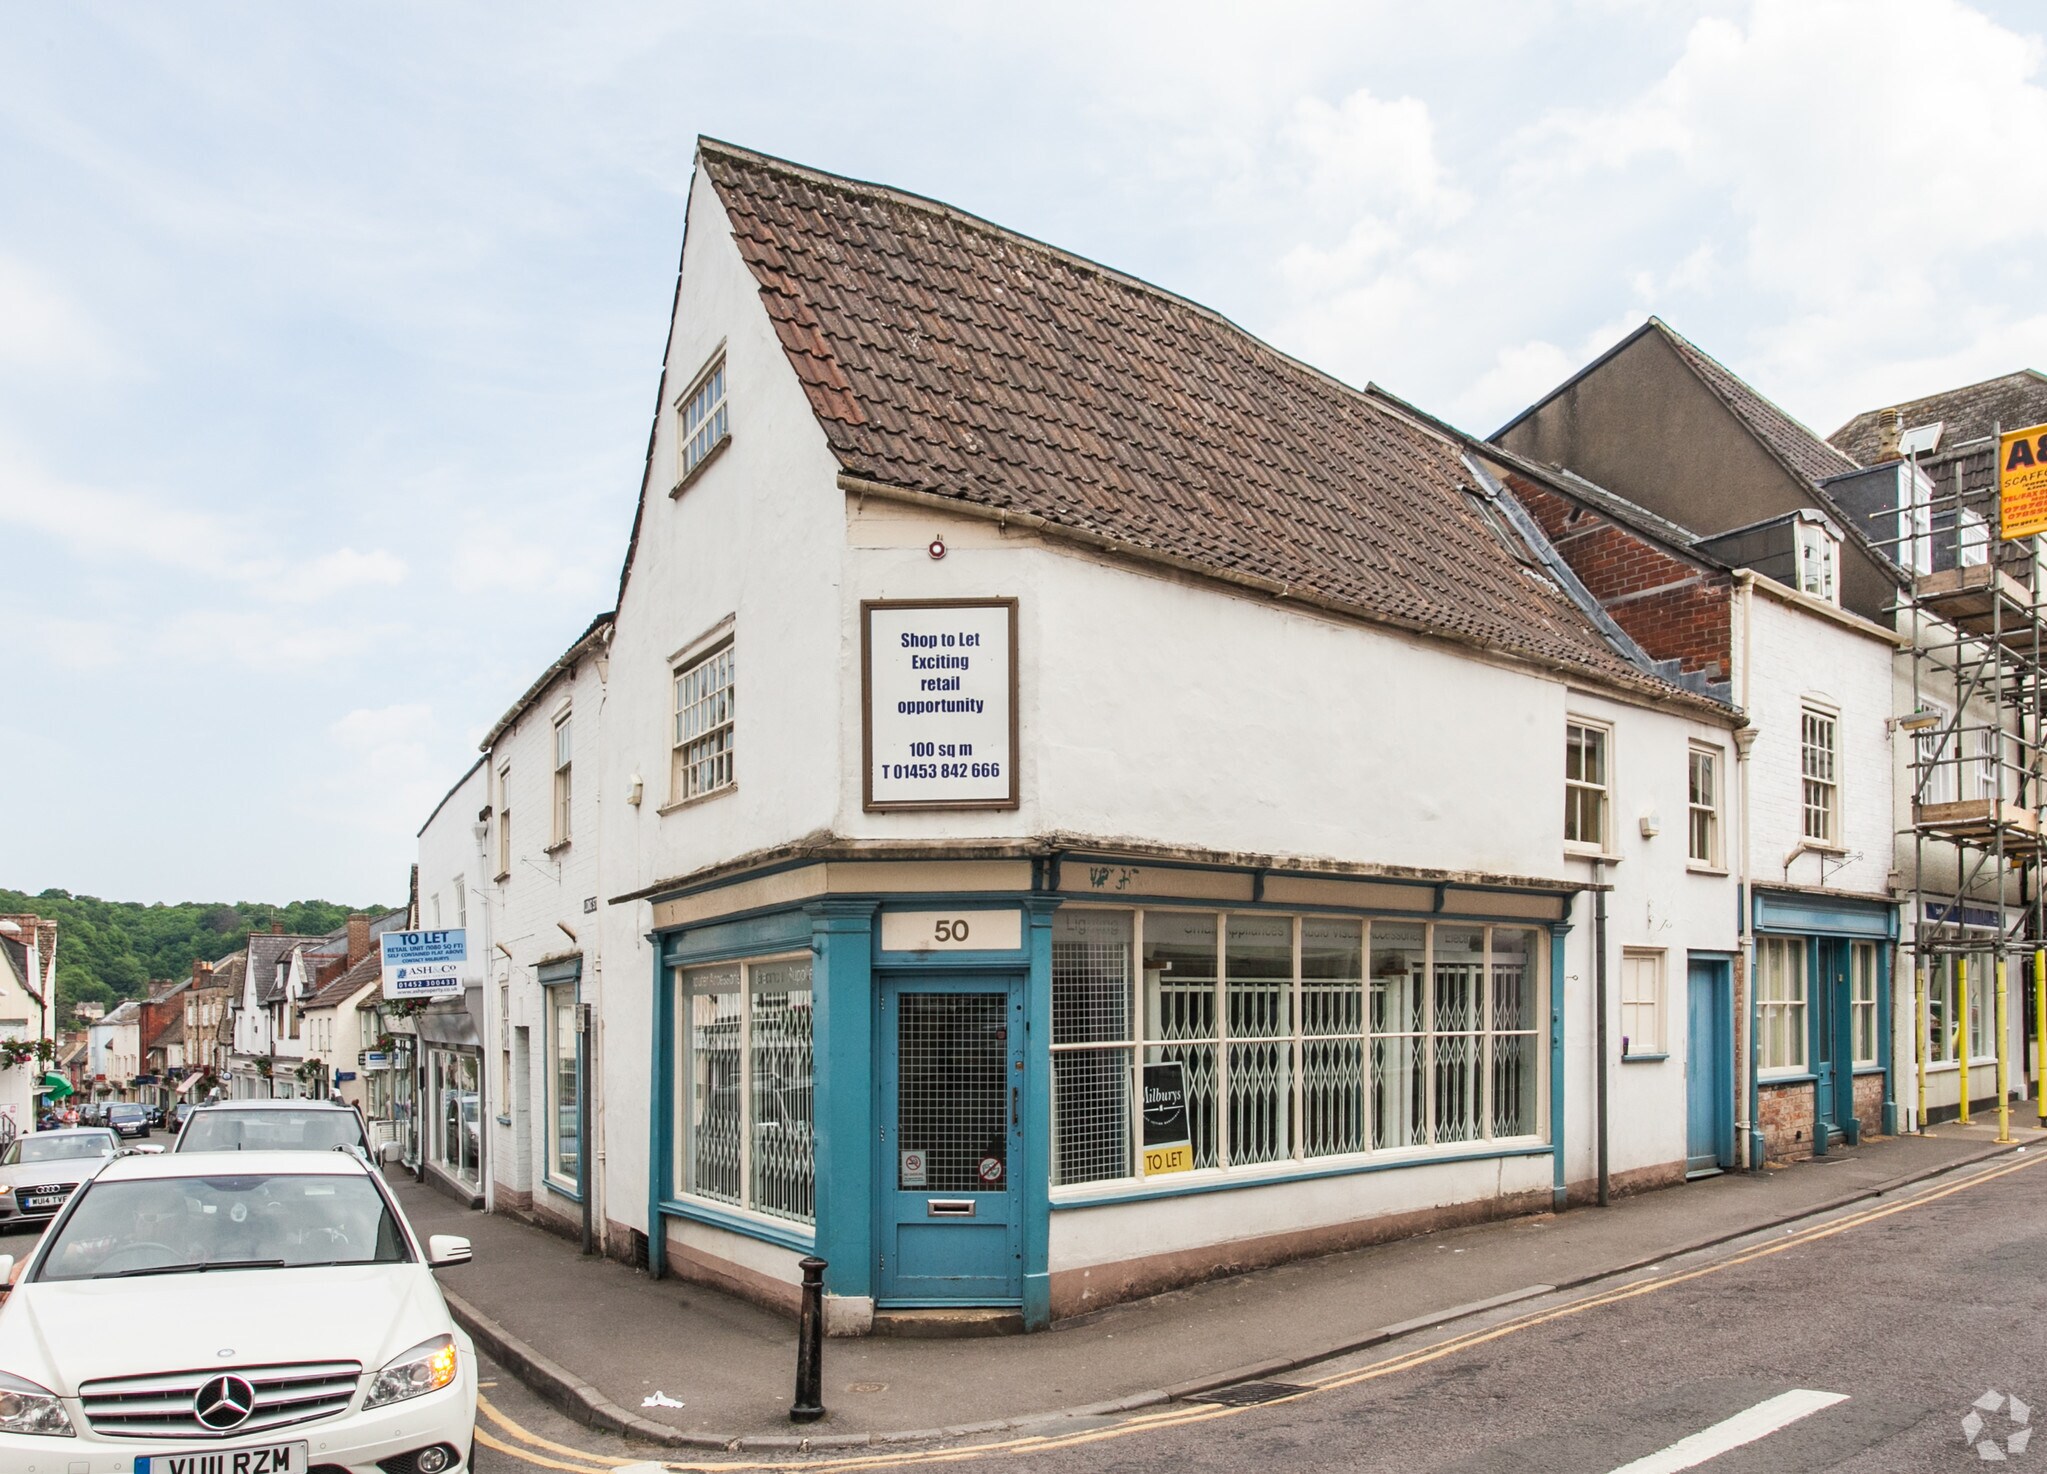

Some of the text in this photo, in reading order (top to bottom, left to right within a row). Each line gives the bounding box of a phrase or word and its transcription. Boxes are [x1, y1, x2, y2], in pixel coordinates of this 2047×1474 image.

[901, 632, 980, 649] Shop to Let
[912, 654, 969, 670] Exciting
[921, 676, 960, 691] retail
[897, 698, 984, 715] opportunity
[909, 742, 973, 758] 100 sq m
[882, 762, 1000, 779] T 01453 842 666
[934, 919, 969, 942] 50
[1066, 914, 1119, 935] Liging
[399, 931, 449, 946] TO LET
[426, 979, 456, 987] 300433
[1146, 1151, 1183, 1170] TO LET
[233, 1446, 290, 1474] RZM
